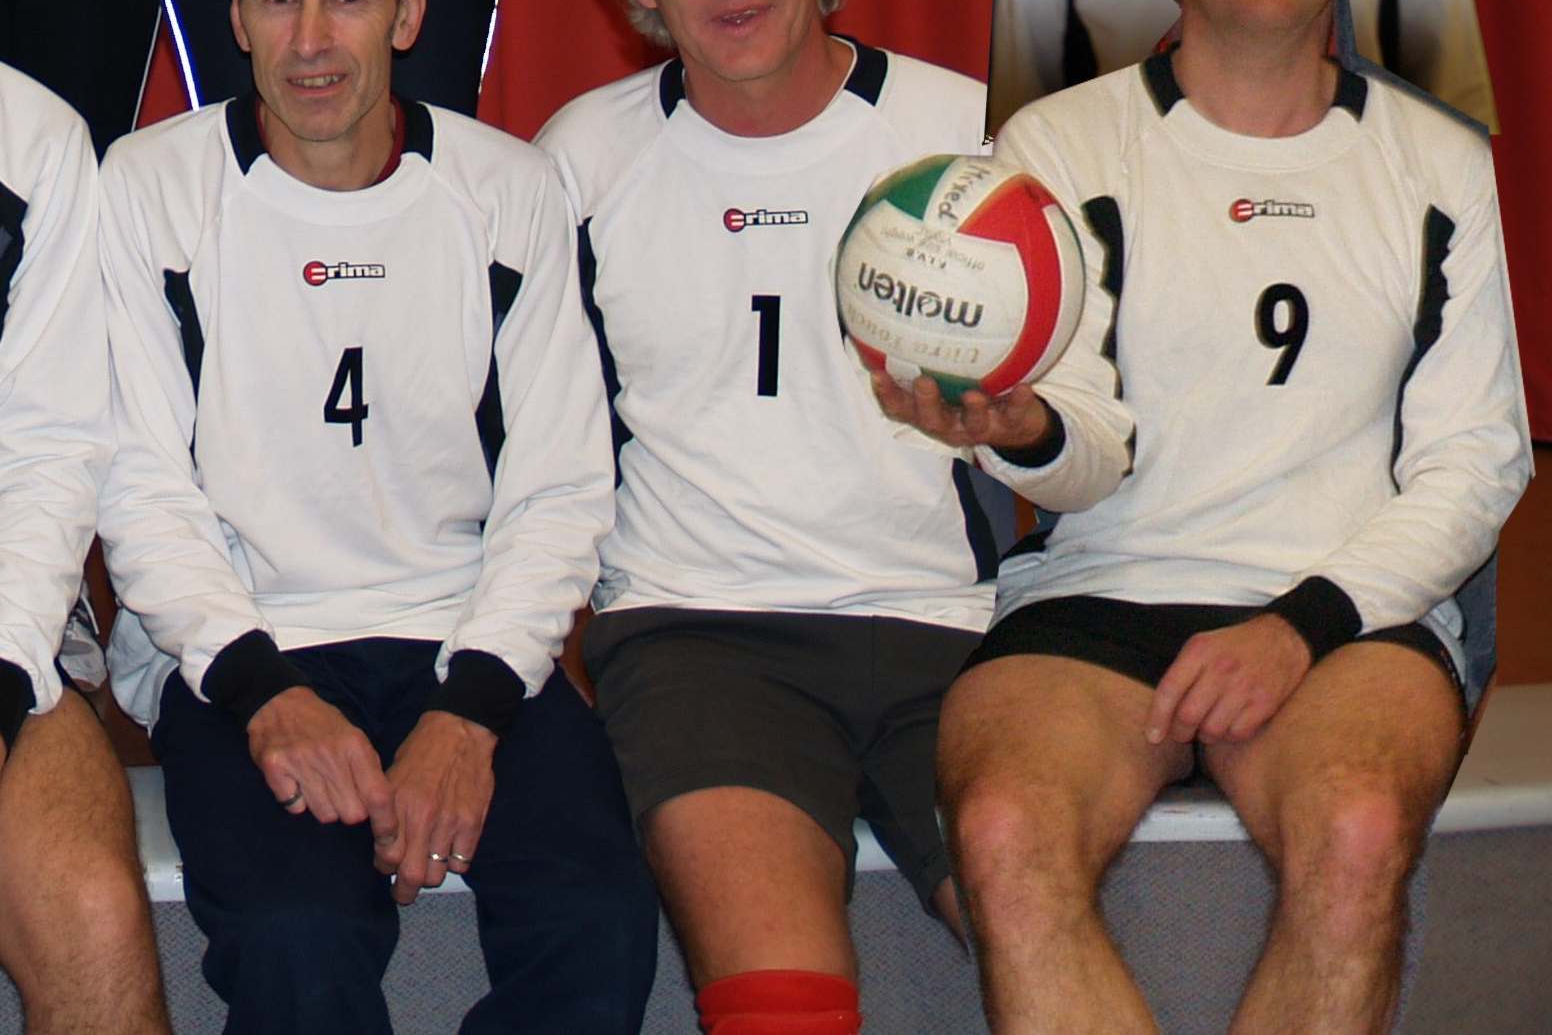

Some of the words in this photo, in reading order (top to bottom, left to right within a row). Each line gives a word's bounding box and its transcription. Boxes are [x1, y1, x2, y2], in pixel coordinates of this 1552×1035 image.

[937, 165, 991, 223] Mixed
[751, 295, 781, 397] 1
[857, 262, 984, 329] molten
[1255, 283, 1309, 386] 9
[323, 346, 369, 447] 4
